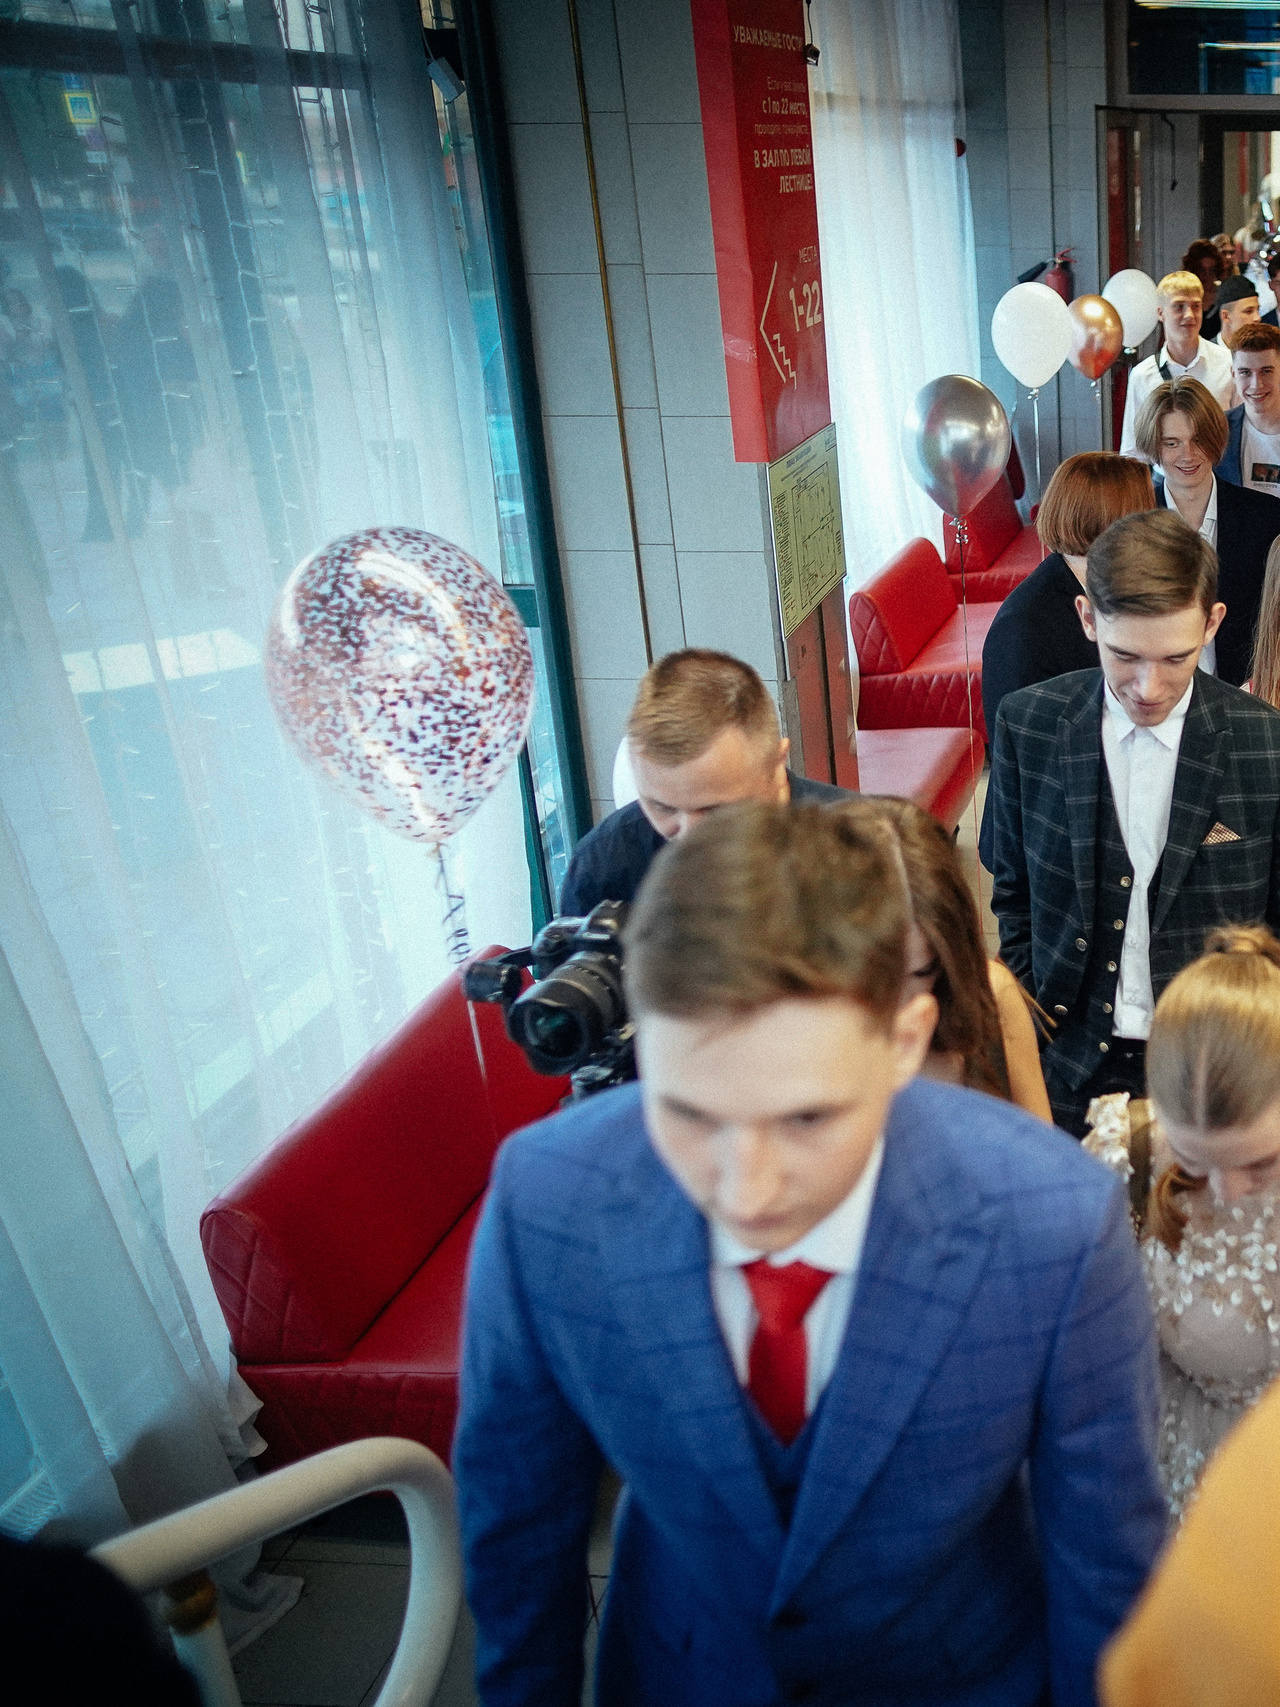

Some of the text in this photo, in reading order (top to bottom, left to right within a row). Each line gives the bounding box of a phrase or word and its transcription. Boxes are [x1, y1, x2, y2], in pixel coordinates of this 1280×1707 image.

[733, 25, 782, 49] УВАЖАЕМЫЕ
[780, 98, 789, 115] 22
[753, 144, 812, 168] В ЗАЛ ПО ЛЕВОЙ
[799, 245, 818, 264] МЕСТА
[789, 280, 822, 332] 1-22
